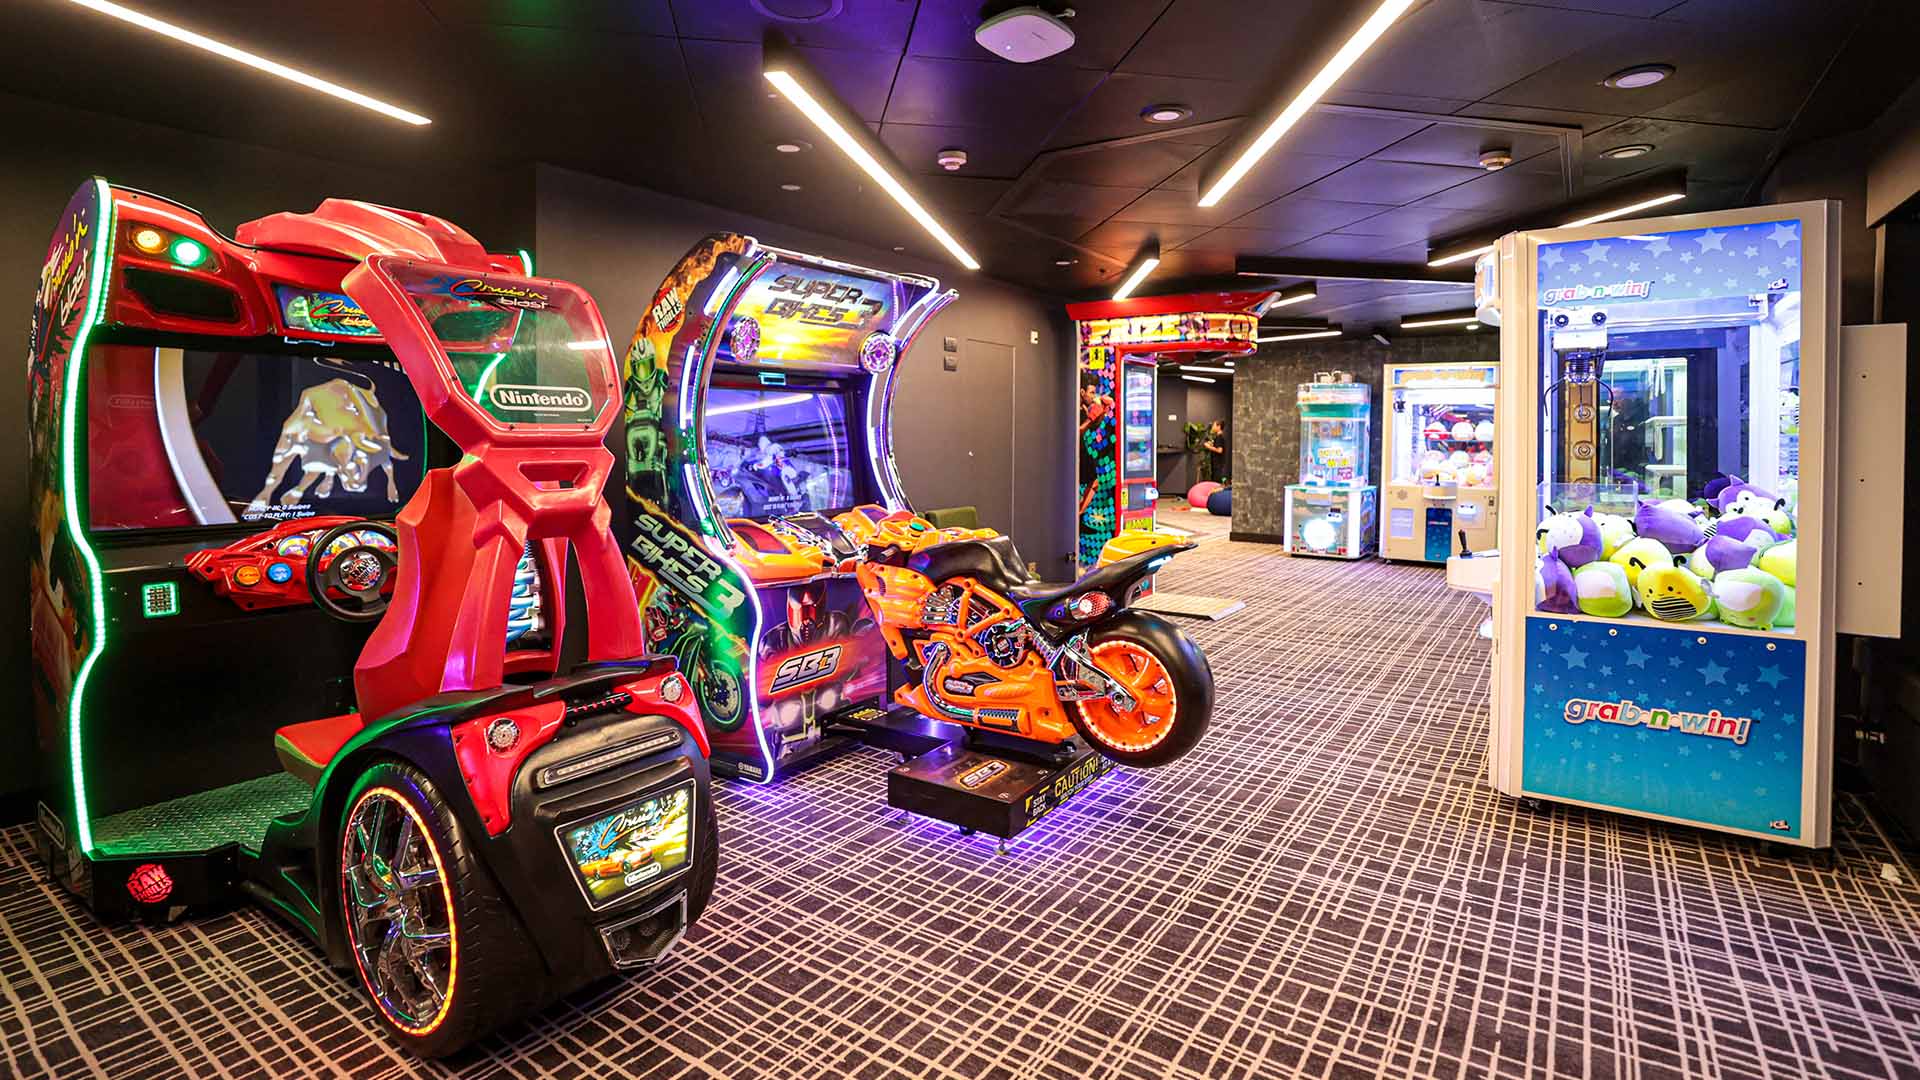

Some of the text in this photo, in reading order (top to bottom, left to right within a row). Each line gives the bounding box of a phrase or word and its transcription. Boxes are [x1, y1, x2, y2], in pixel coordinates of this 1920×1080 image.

[449, 279, 548, 300] Cruis'n
[499, 296, 548, 309] blast
[768, 274, 863, 303] SUPER
[652, 287, 680, 321] RAW
[657, 303, 683, 331] THRILLS
[765, 298, 850, 324] BIKES
[1088, 314, 1181, 346] PRIZE
[499, 389, 584, 406] Nintendo
[634, 514, 722, 581] SUPER
[631, 534, 745, 617] BIKES 3
[1054, 757, 1099, 797] CAUTION!
[1032, 802, 1047, 817] BACK
[1033, 793, 1047, 808] STAY
[128, 864, 167, 896] RAW
